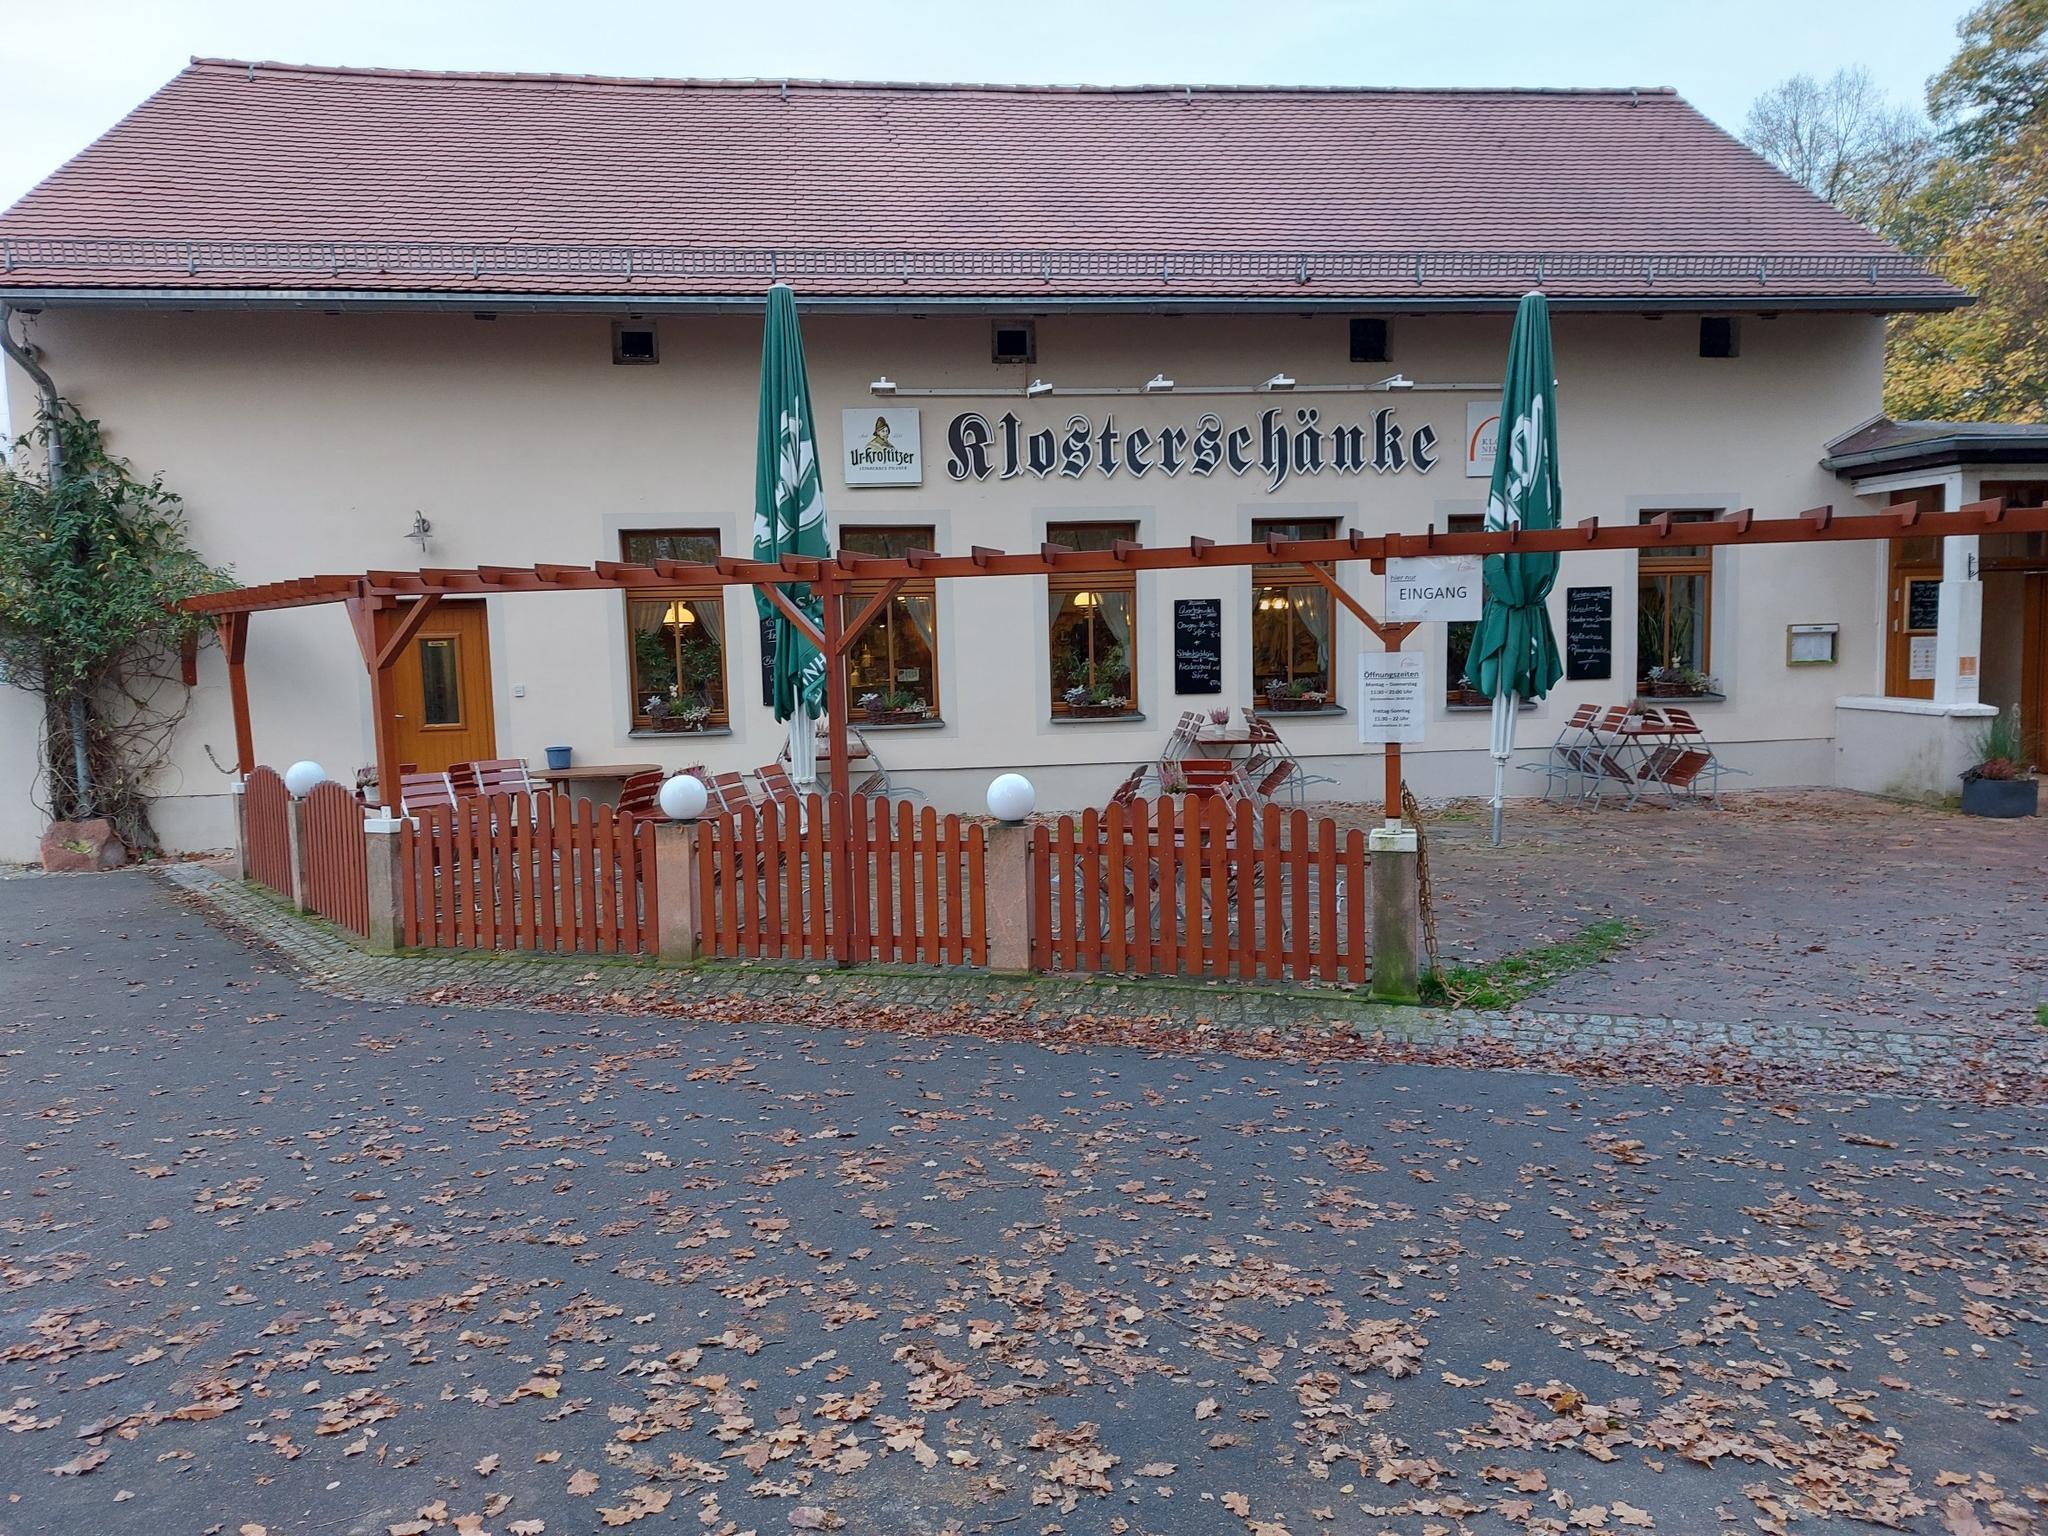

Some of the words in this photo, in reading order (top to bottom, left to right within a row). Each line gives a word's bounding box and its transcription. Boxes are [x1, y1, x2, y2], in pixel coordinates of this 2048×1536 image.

[945, 407, 1440, 494] Klosterschänke
[1400, 586, 1467, 601] EINGANG
[1364, 670, 1419, 679] Öffnungszeiten
